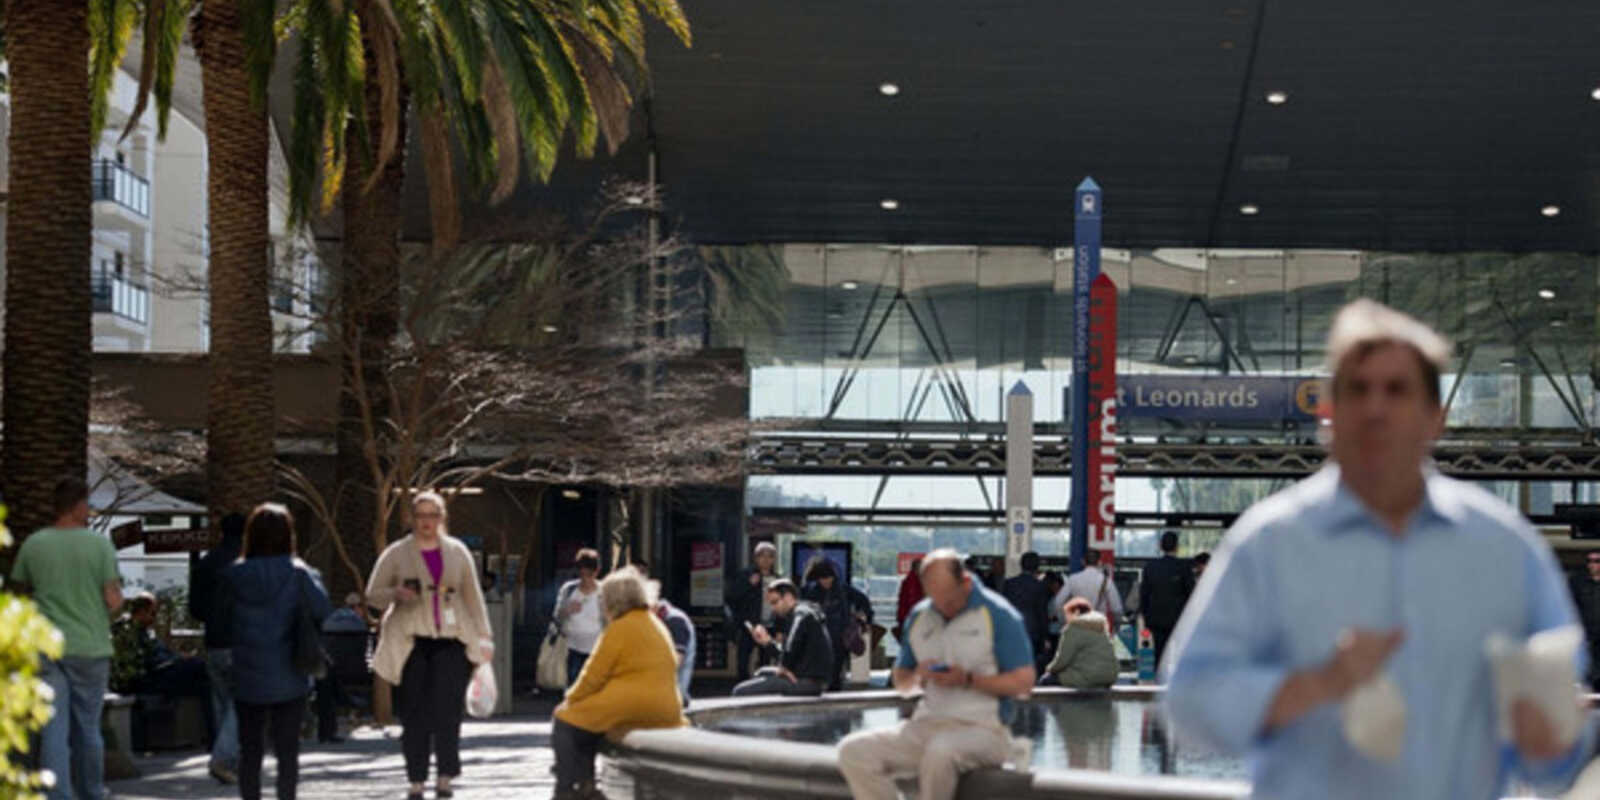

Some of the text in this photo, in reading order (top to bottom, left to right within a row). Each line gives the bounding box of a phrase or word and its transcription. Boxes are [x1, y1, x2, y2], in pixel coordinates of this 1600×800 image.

[1076, 245, 1088, 292] station
[1136, 384, 1259, 407] Leonards
[1088, 397, 1117, 550] Forum
